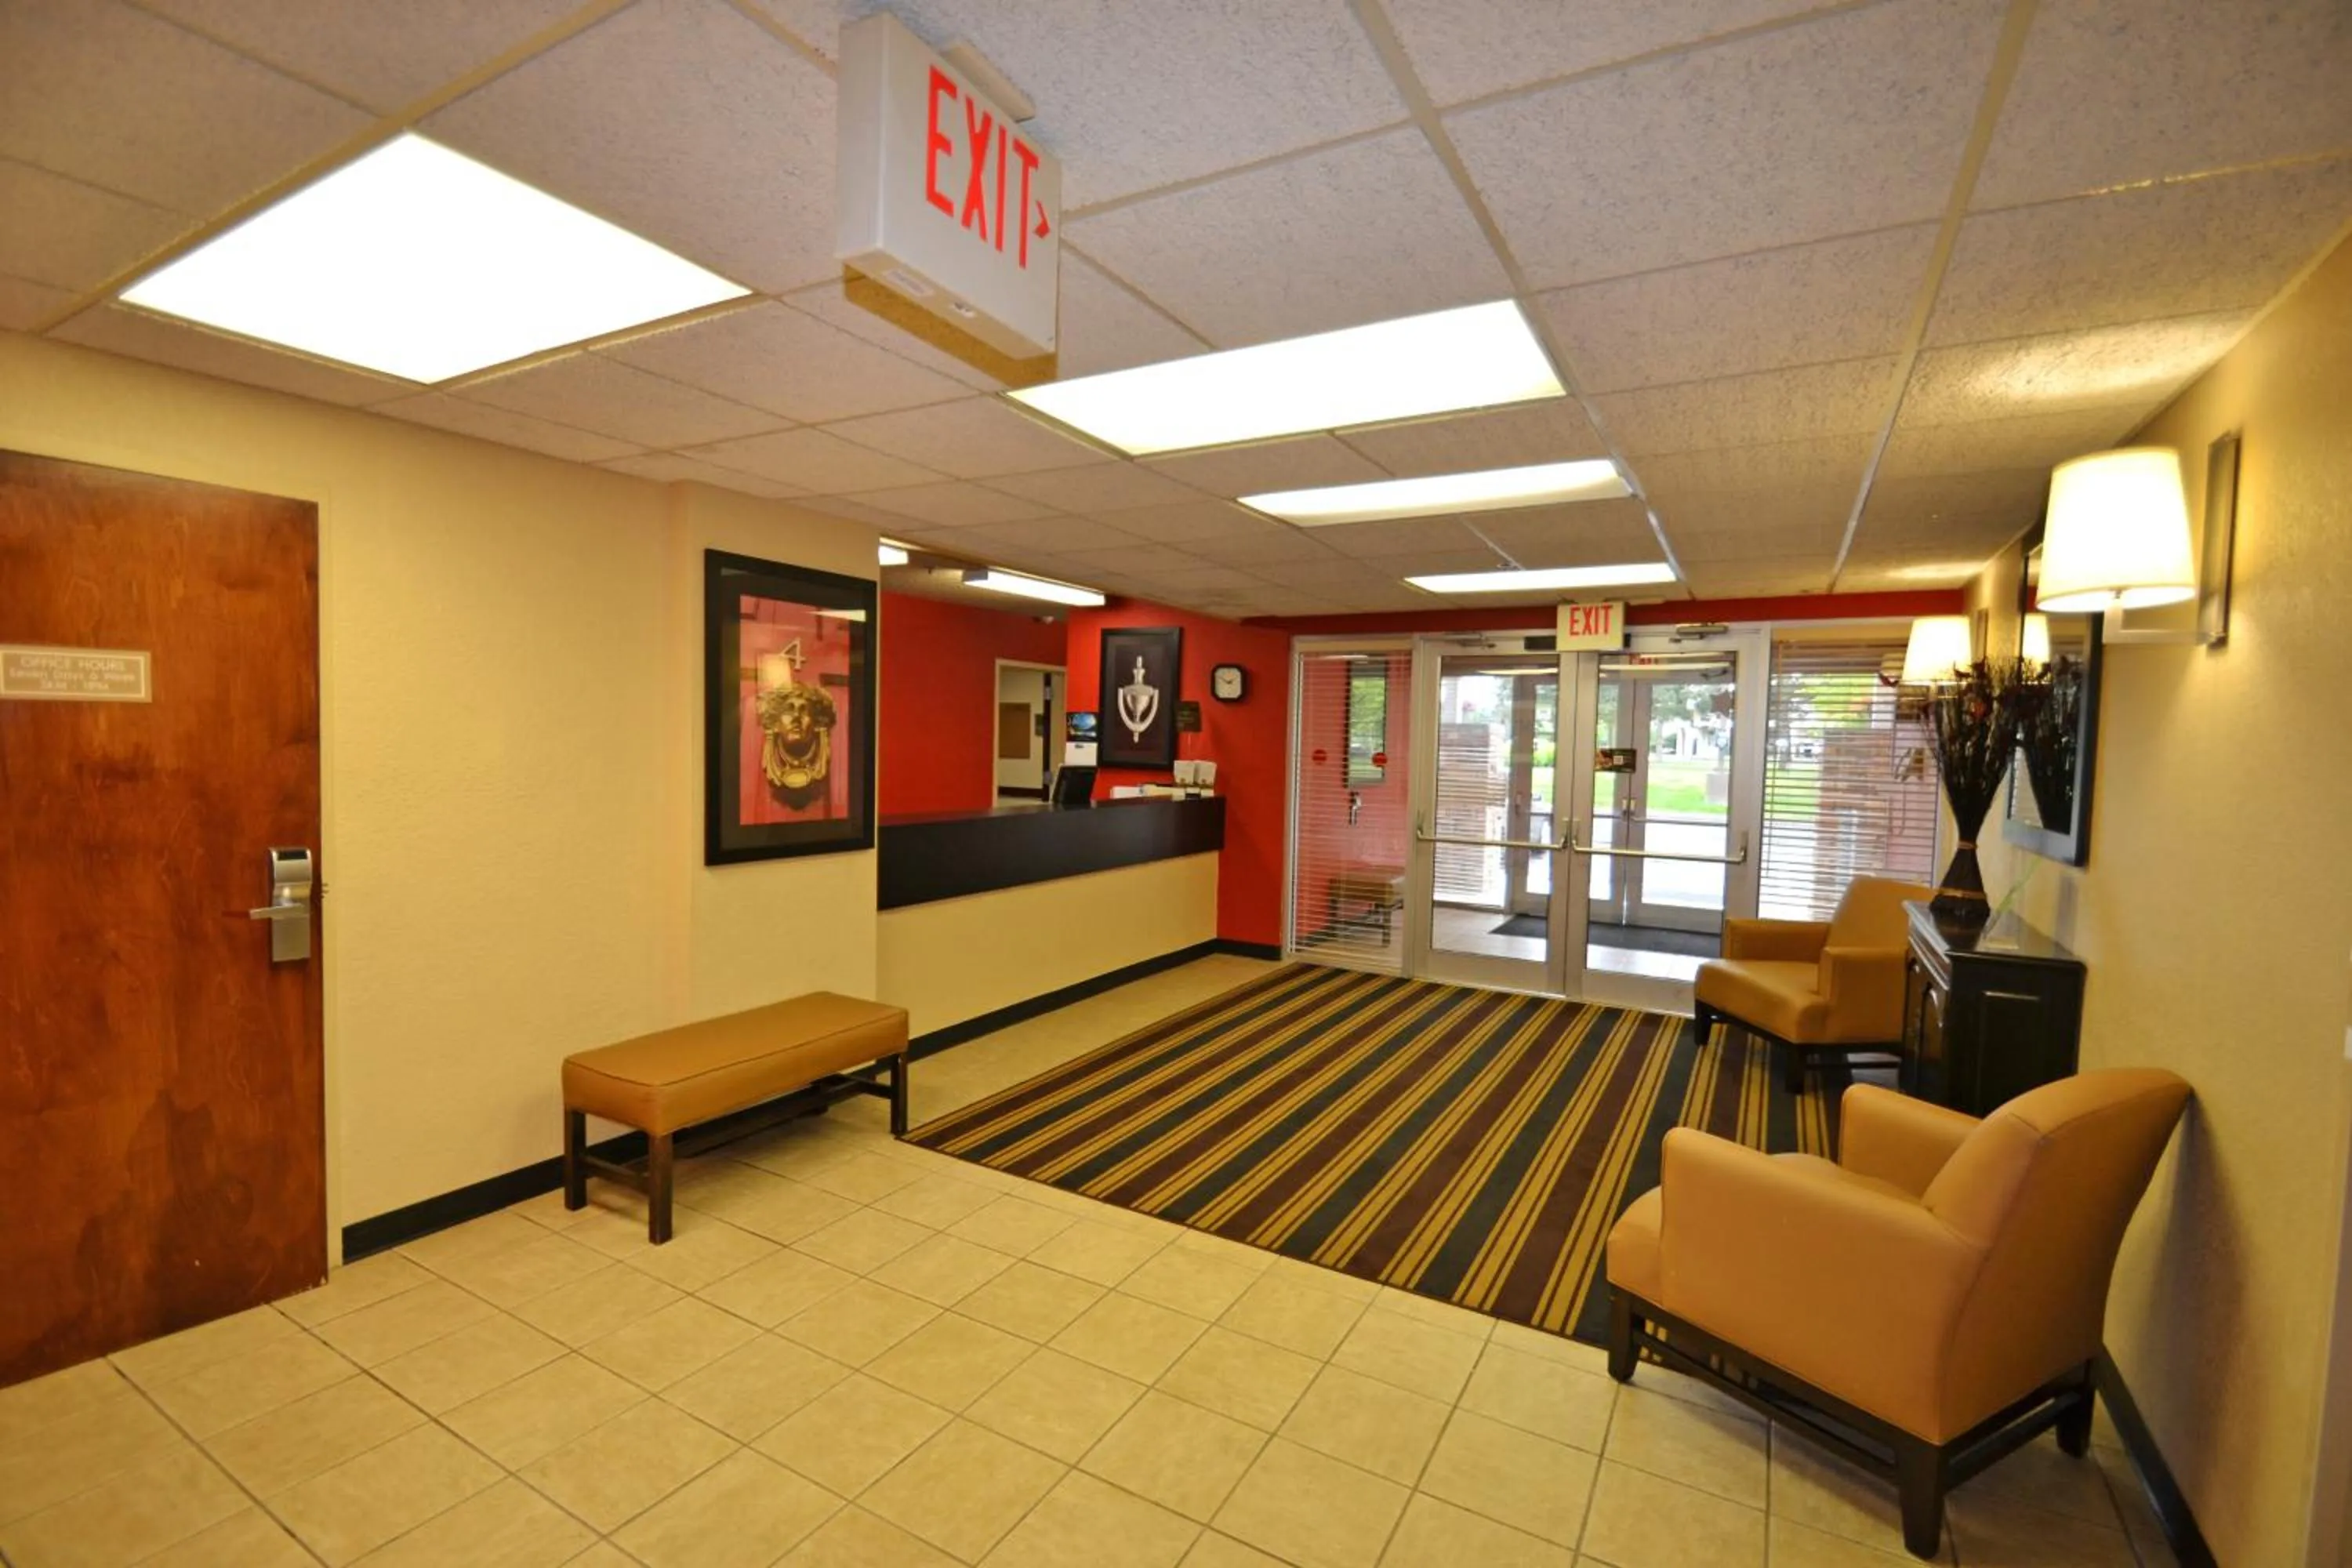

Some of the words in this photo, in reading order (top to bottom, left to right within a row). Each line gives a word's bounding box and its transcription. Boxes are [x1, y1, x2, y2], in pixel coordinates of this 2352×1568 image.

[925, 64, 1040, 270] EXIT
[1570, 604, 1613, 637] EXIT
[780, 637, 807, 671] 4
